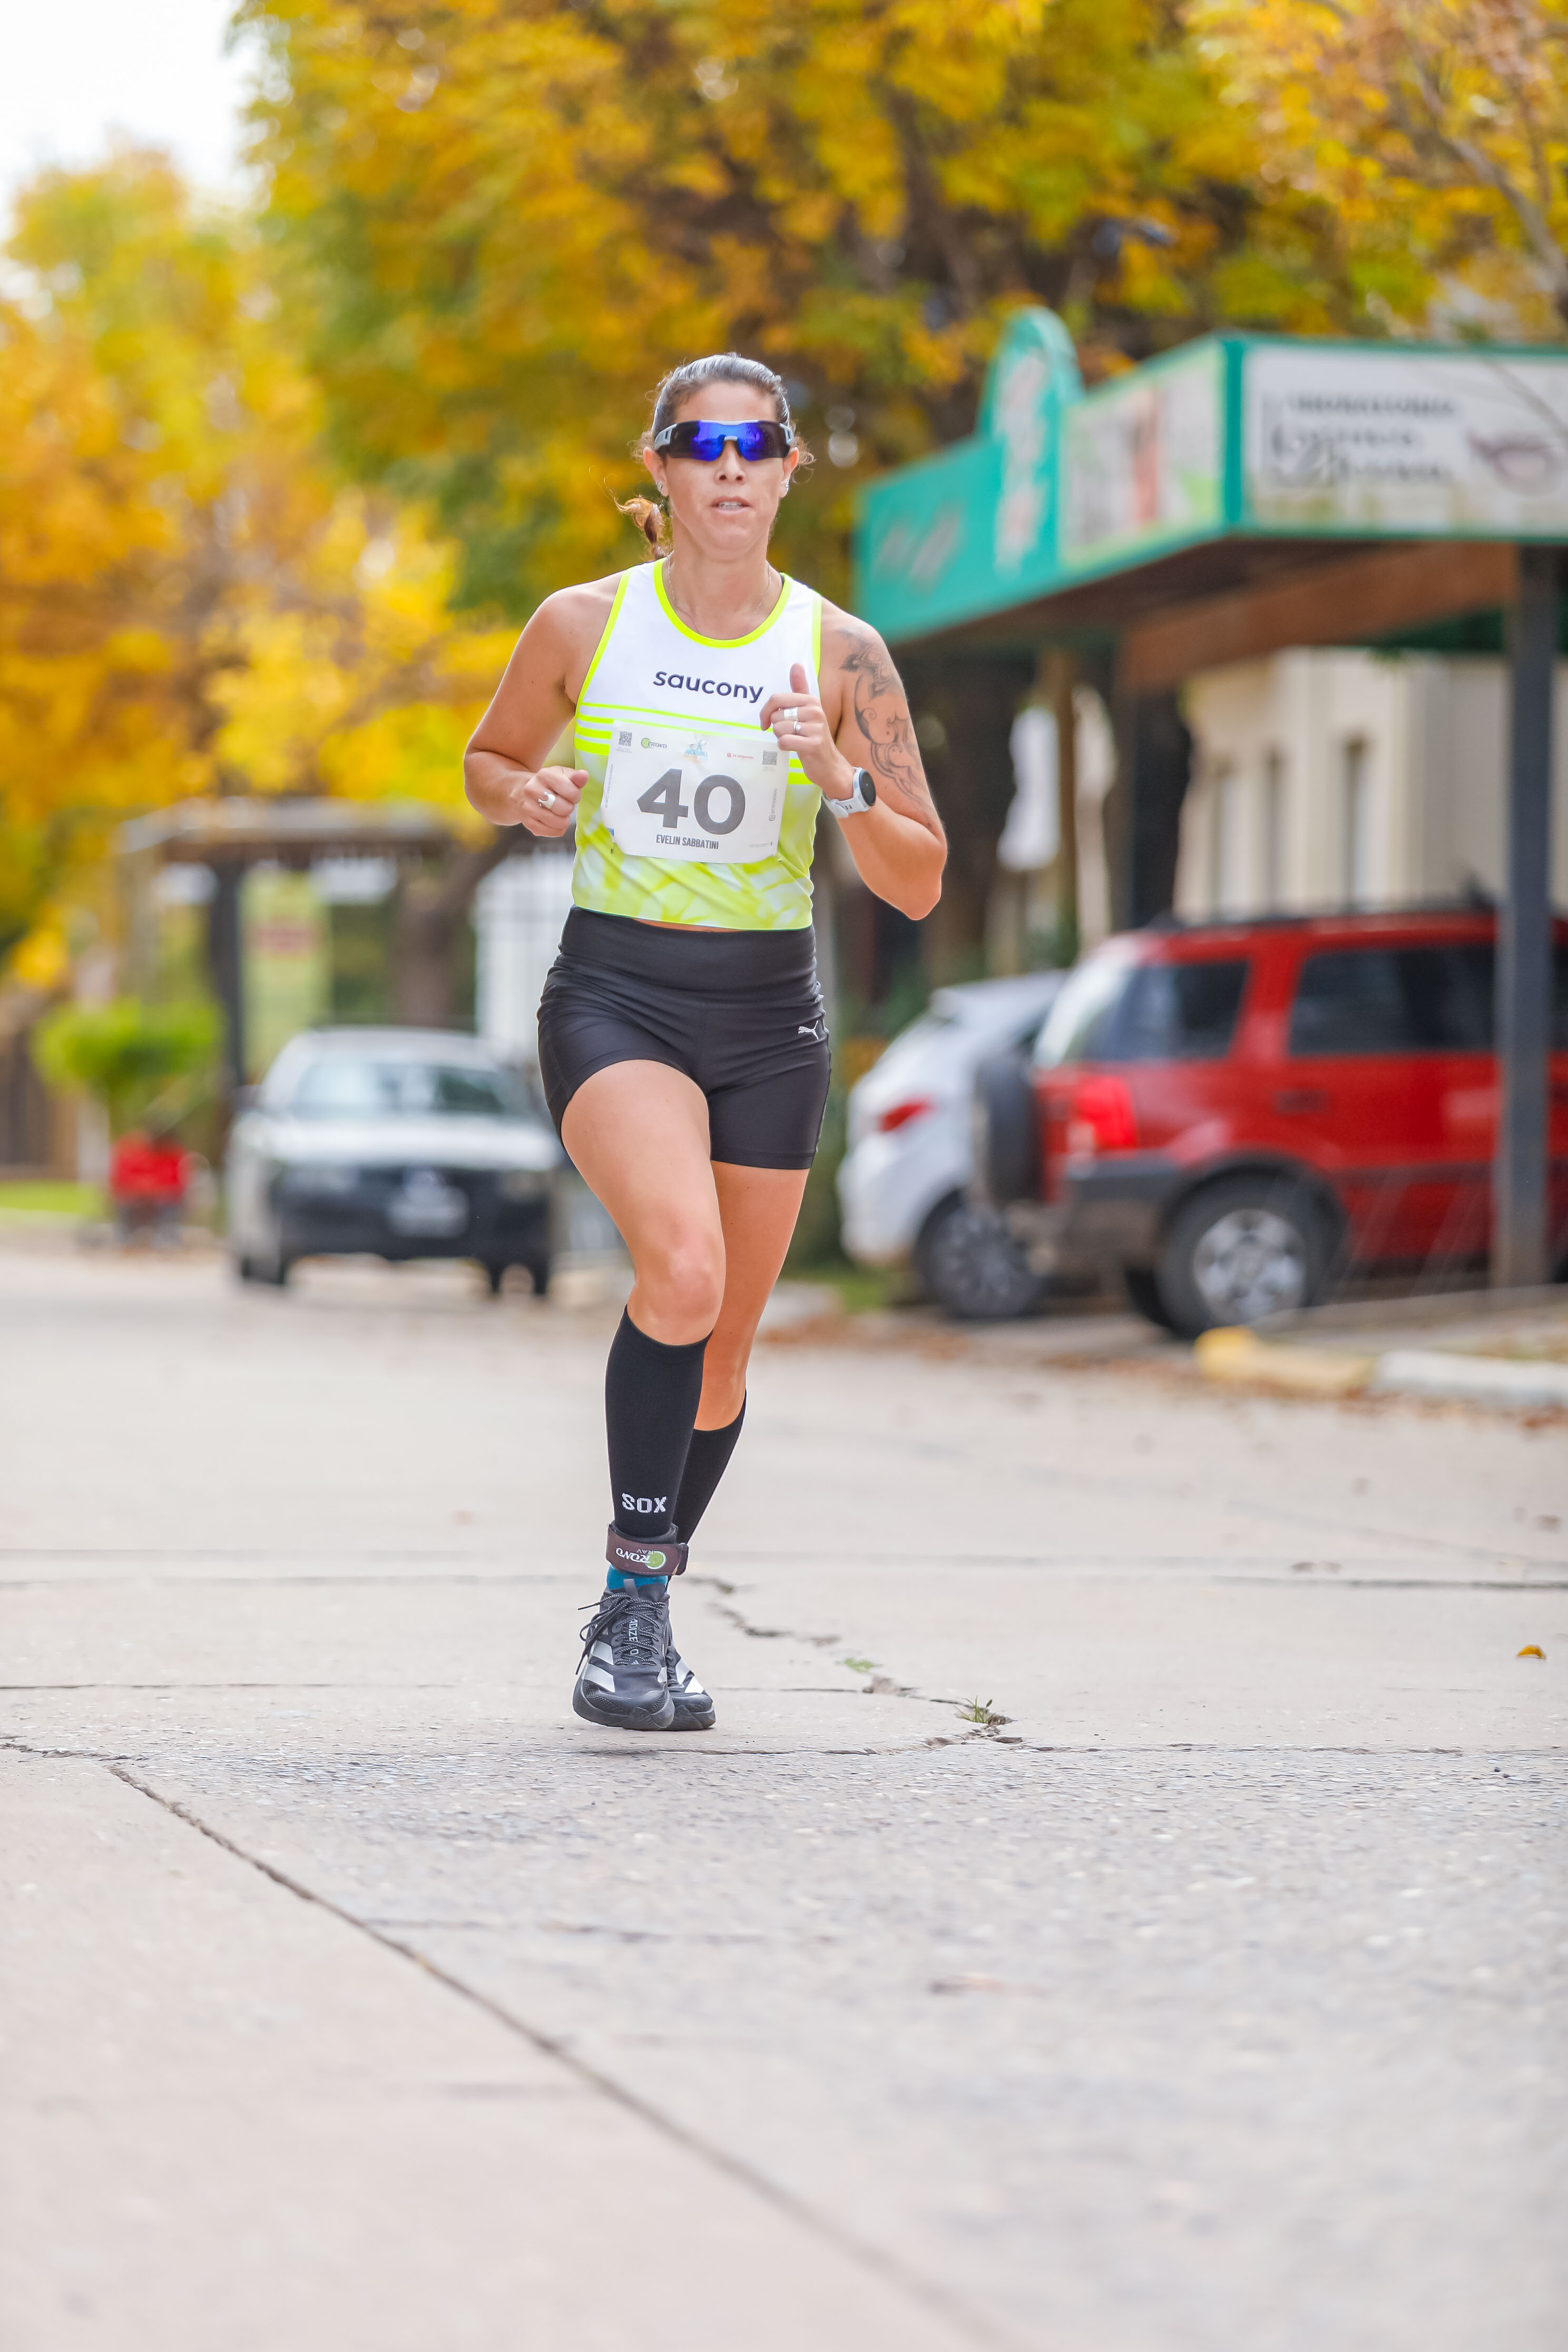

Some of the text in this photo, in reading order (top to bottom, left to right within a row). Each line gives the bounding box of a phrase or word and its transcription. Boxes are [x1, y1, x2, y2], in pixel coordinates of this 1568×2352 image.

[653, 671, 764, 703] saucony
[636, 768, 746, 835] 40
[656, 834, 719, 849] EVELIN SABBATINI
[622, 1493, 667, 1513] SOX
[629, 1618, 639, 1655] ADIZEO
